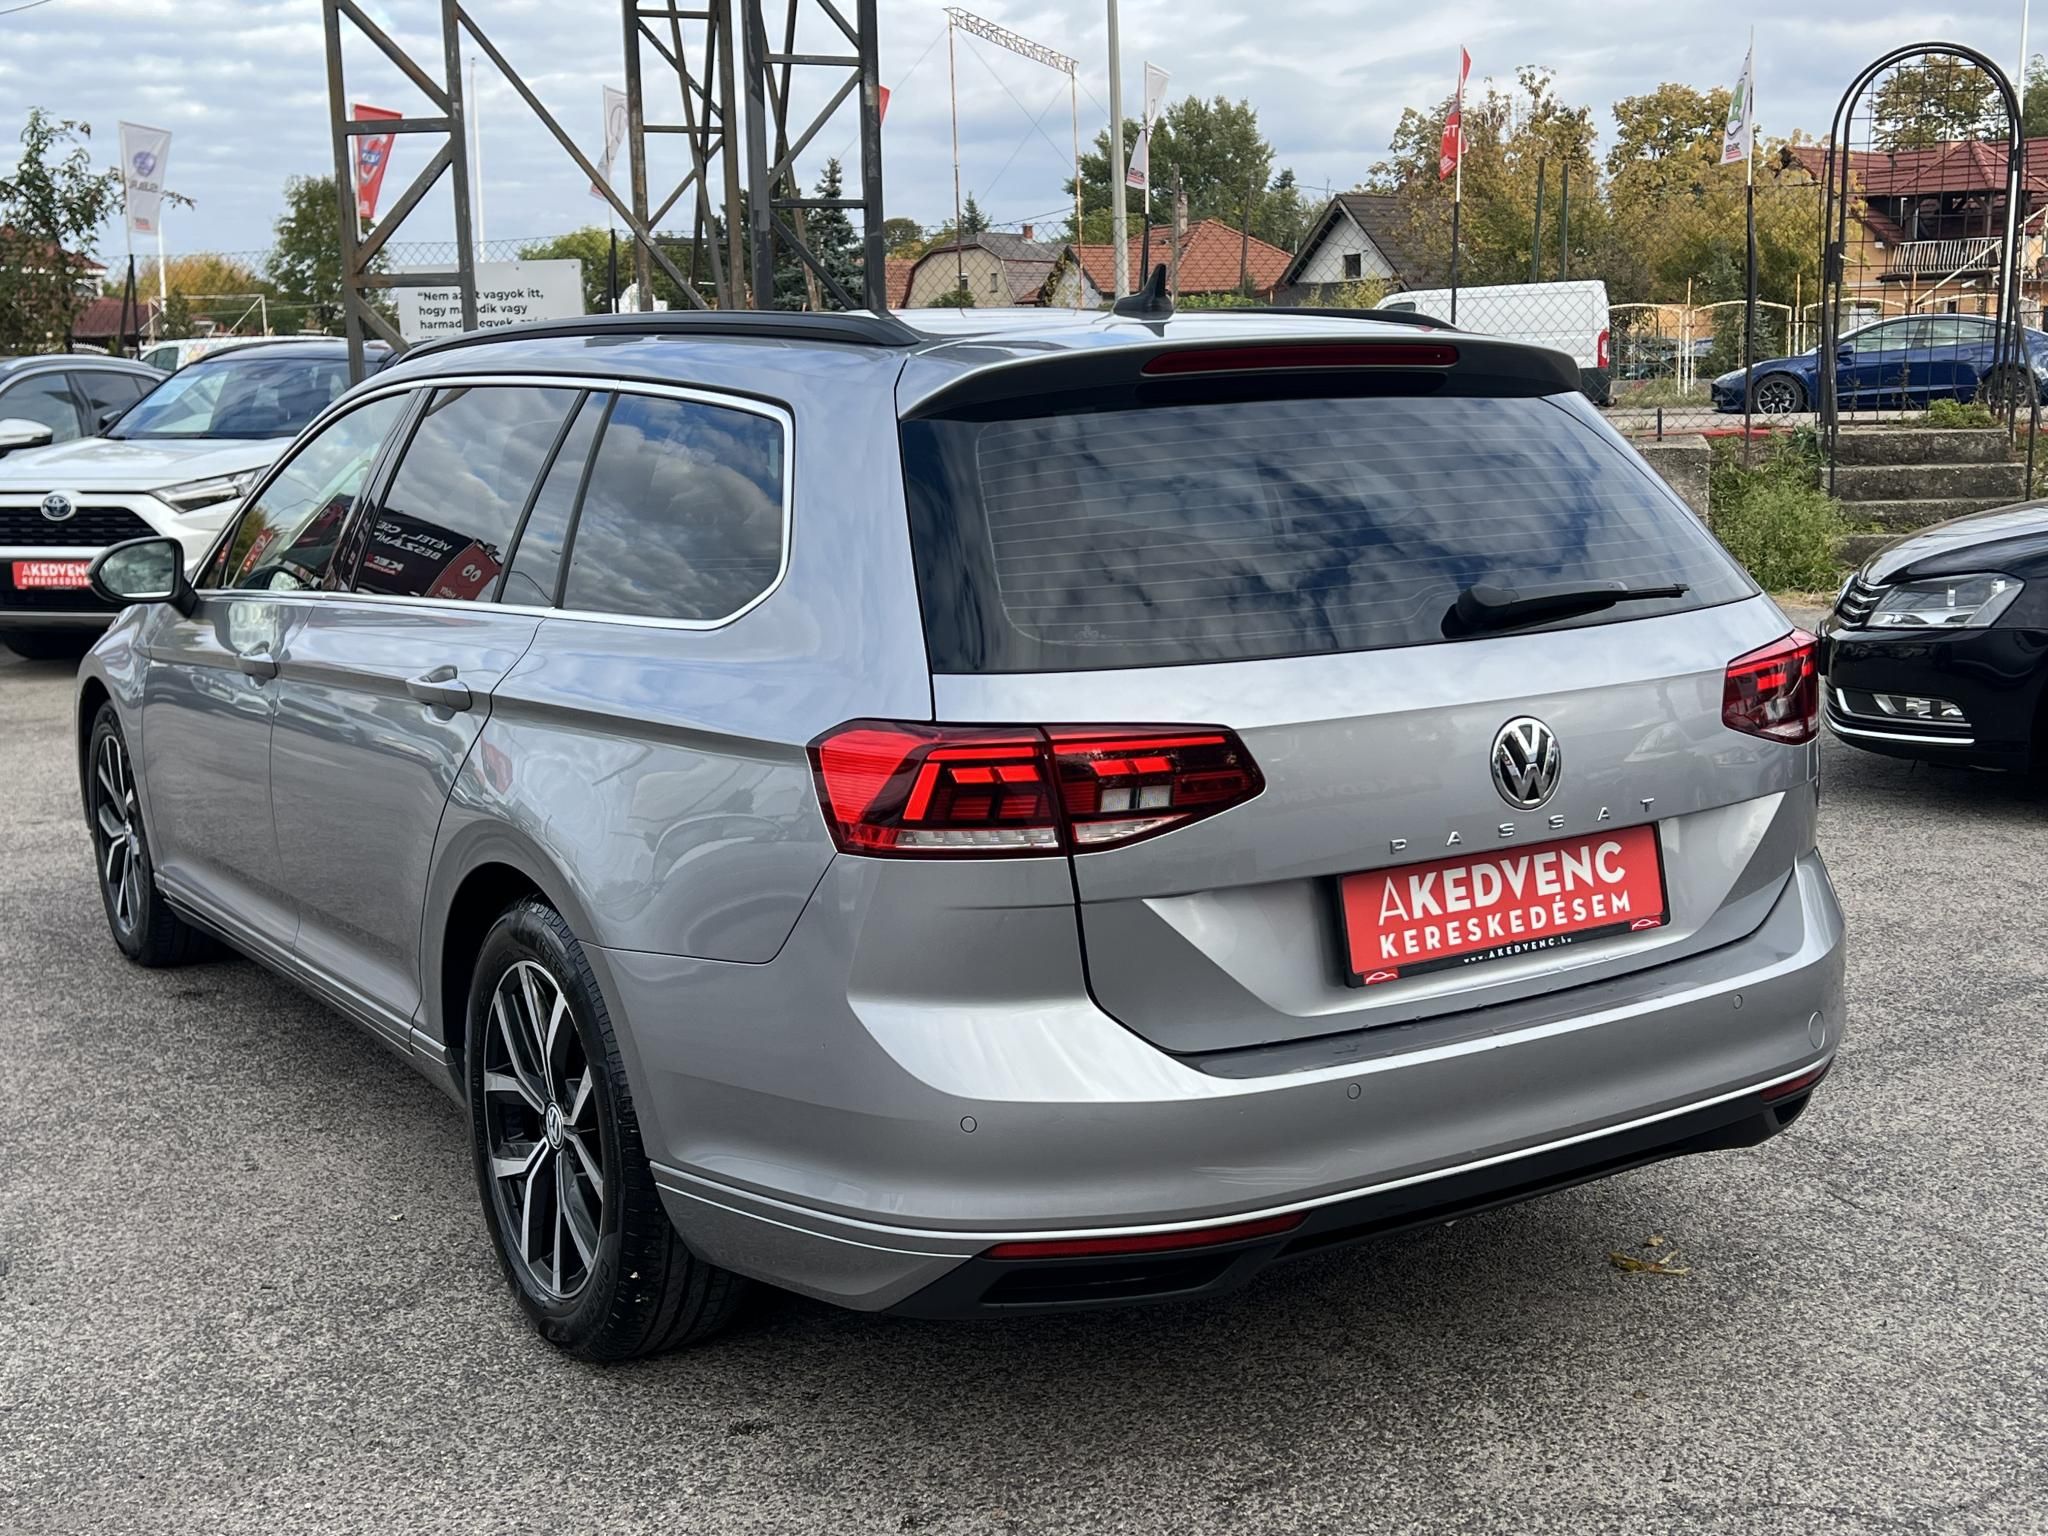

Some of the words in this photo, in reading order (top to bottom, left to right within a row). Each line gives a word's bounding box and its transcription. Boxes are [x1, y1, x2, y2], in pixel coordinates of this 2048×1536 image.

[419, 306, 446, 318] hogy
[500, 304, 528, 316] vagy
[483, 289, 524, 302] vagyok
[527, 288, 544, 300] itt,
[1390, 798, 1655, 854] PASSAT
[1378, 841, 1626, 926] AKEDVENC
[1380, 889, 1631, 959] KERESKEDÉSEM
